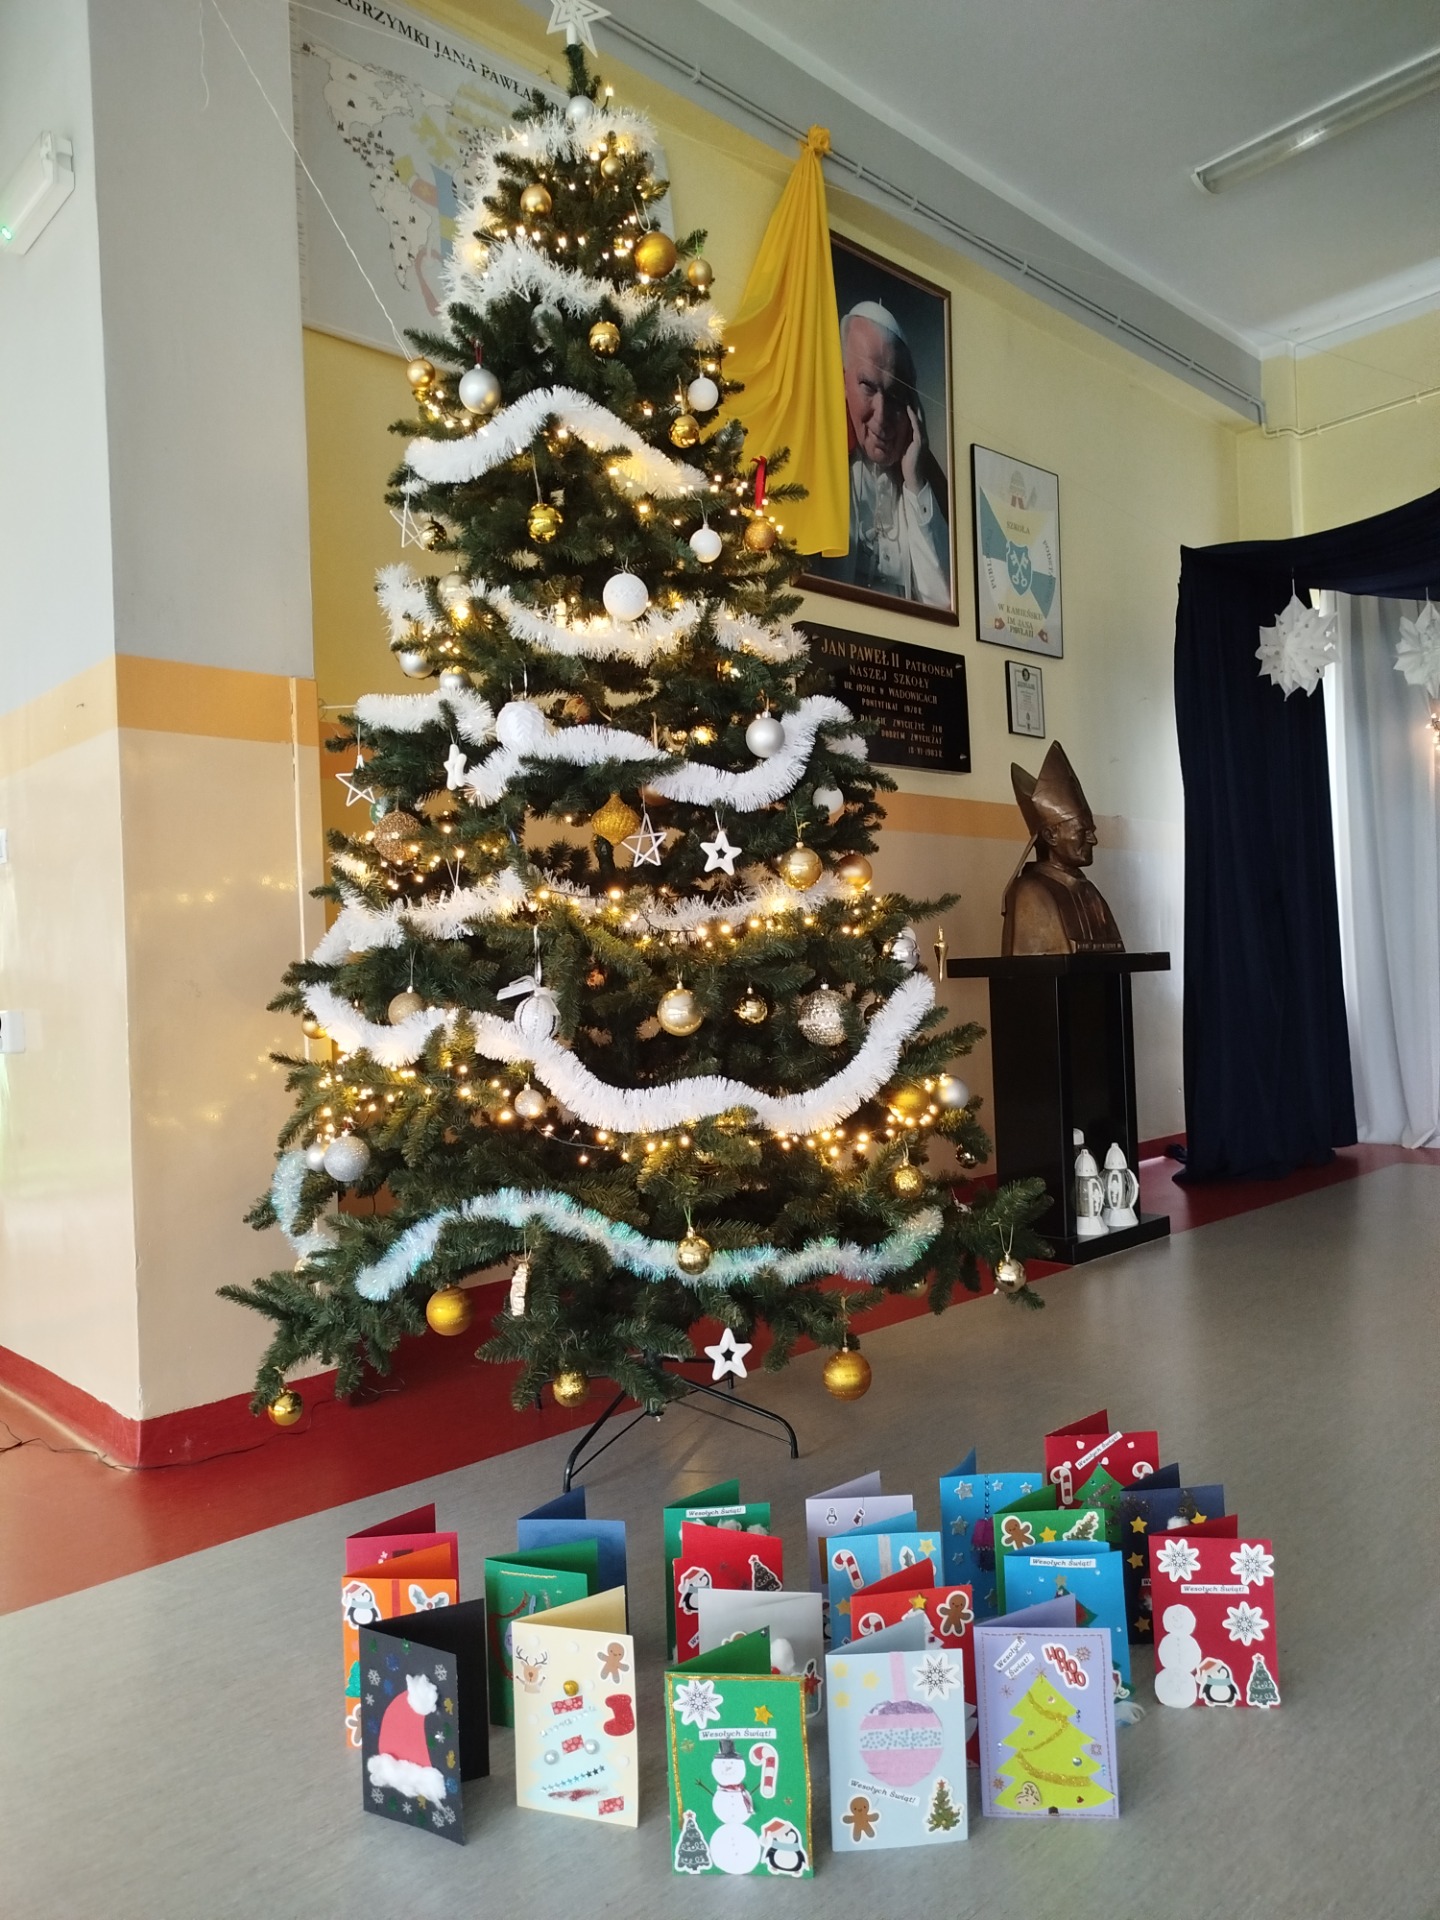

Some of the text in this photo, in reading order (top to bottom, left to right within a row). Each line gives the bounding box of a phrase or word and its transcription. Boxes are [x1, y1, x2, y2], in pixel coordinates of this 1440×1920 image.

[336, 0, 532, 102] GRZYMKI JANA PAWŁA
[821, 638, 954, 678] JAN PAWEŁ II PATRONEM
[849, 664, 929, 689] NASZEJ SZKOŁY
[889, 687, 938, 704] WADOWICACH
[1045, 1646, 1086, 1687] HO HO HO
[702, 1728, 771, 1740] Wesołych Świąt!
[851, 1780, 916, 1803] Wesołych Świąt!
